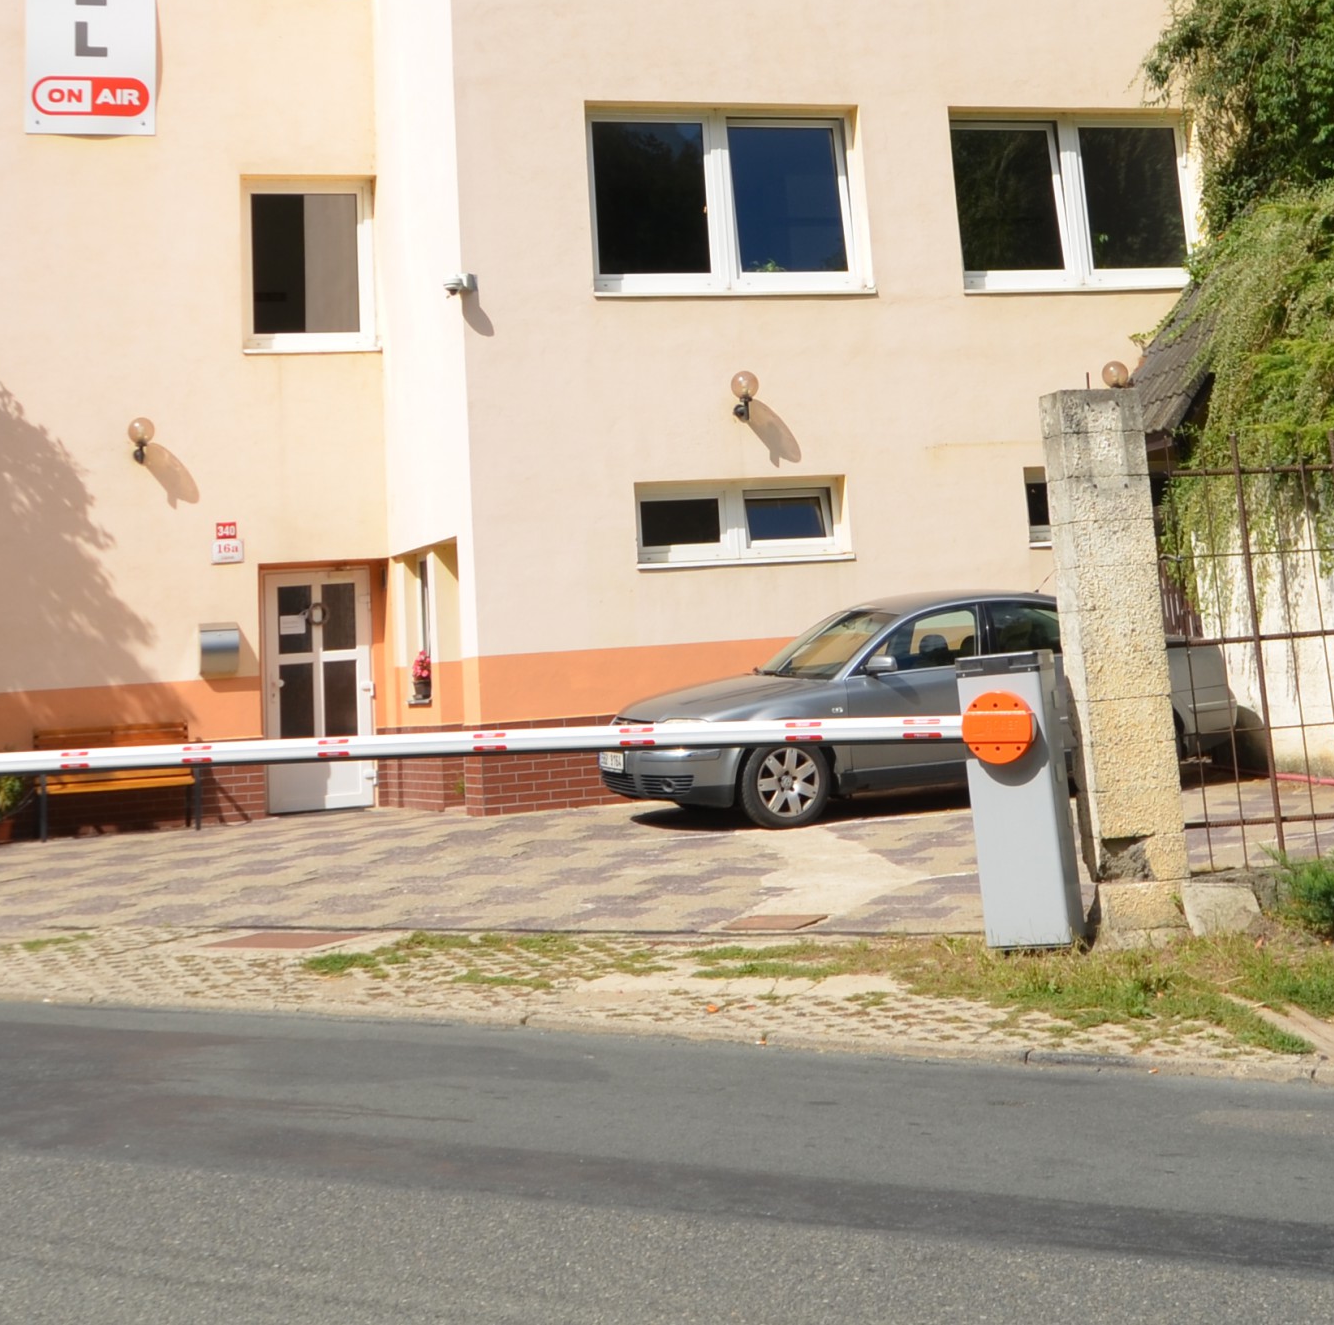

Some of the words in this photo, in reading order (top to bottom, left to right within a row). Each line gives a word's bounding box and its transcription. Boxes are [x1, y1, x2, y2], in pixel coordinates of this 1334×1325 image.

[47, 87, 83, 104] ON
[94, 87, 142, 106] AIR
[217, 525, 236, 536] 340
[218, 543, 238, 554] 16a
